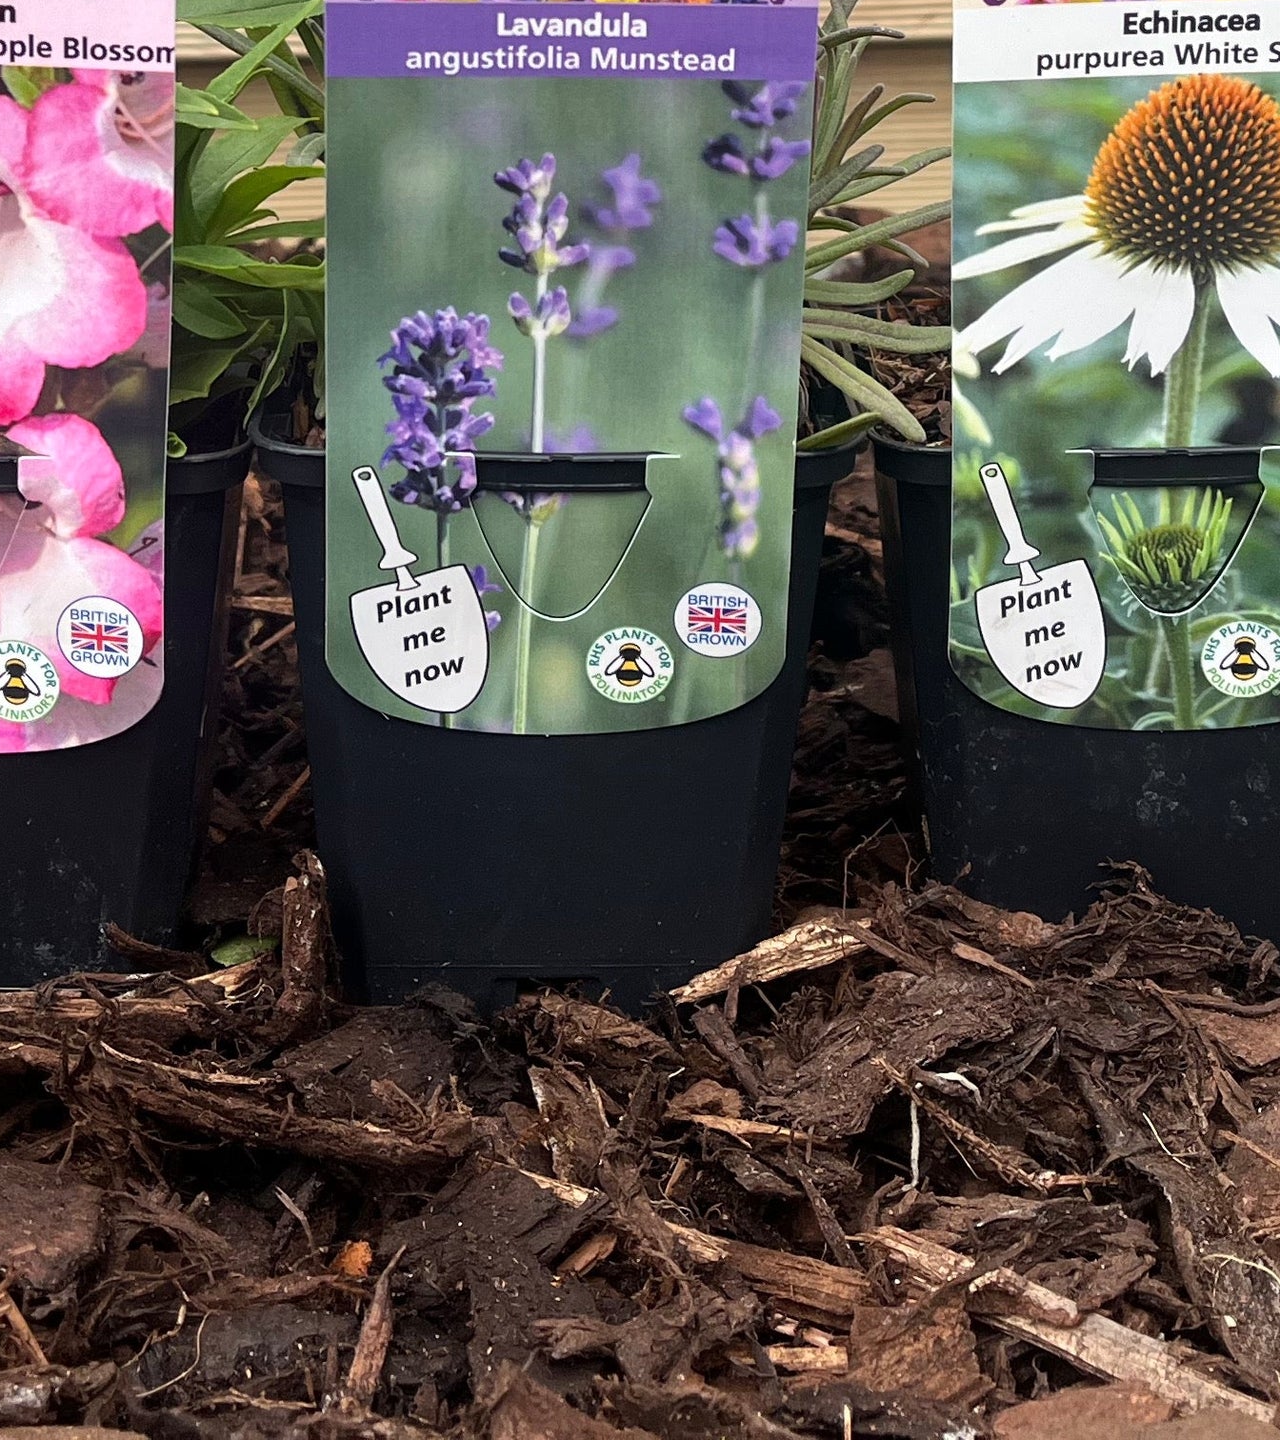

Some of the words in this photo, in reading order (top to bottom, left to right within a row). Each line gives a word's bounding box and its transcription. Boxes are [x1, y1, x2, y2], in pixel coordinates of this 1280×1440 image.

[497, 13, 647, 38] Lavandula
[1123, 9, 1261, 36] Echinacea
[406, 44, 580, 76] angustifolia
[591, 48, 736, 72] Munstead
[1036, 47, 1164, 76] purpurea
[1174, 42, 1258, 65] White
[377, 585, 451, 623] Plant
[688, 595, 748, 607] BRITISH
[1001, 580, 1071, 618] Plant
[71, 609, 128, 624] BRITISH
[403, 626, 445, 651] me
[687, 634, 746, 646] GROWN
[1025, 621, 1065, 646] me
[1205, 638, 1220, 661] RHS
[1220, 623, 1271, 639] PLANTS
[71, 651, 129, 666] GROWN
[589, 644, 605, 666] RHS
[605, 629, 657, 645] PLANTS
[655, 647, 671, 668] FOR
[41, 663, 57, 687] FOR
[406, 657, 464, 687] now
[1026, 651, 1083, 682] now
[593, 673, 669, 701] POLLINATORS
